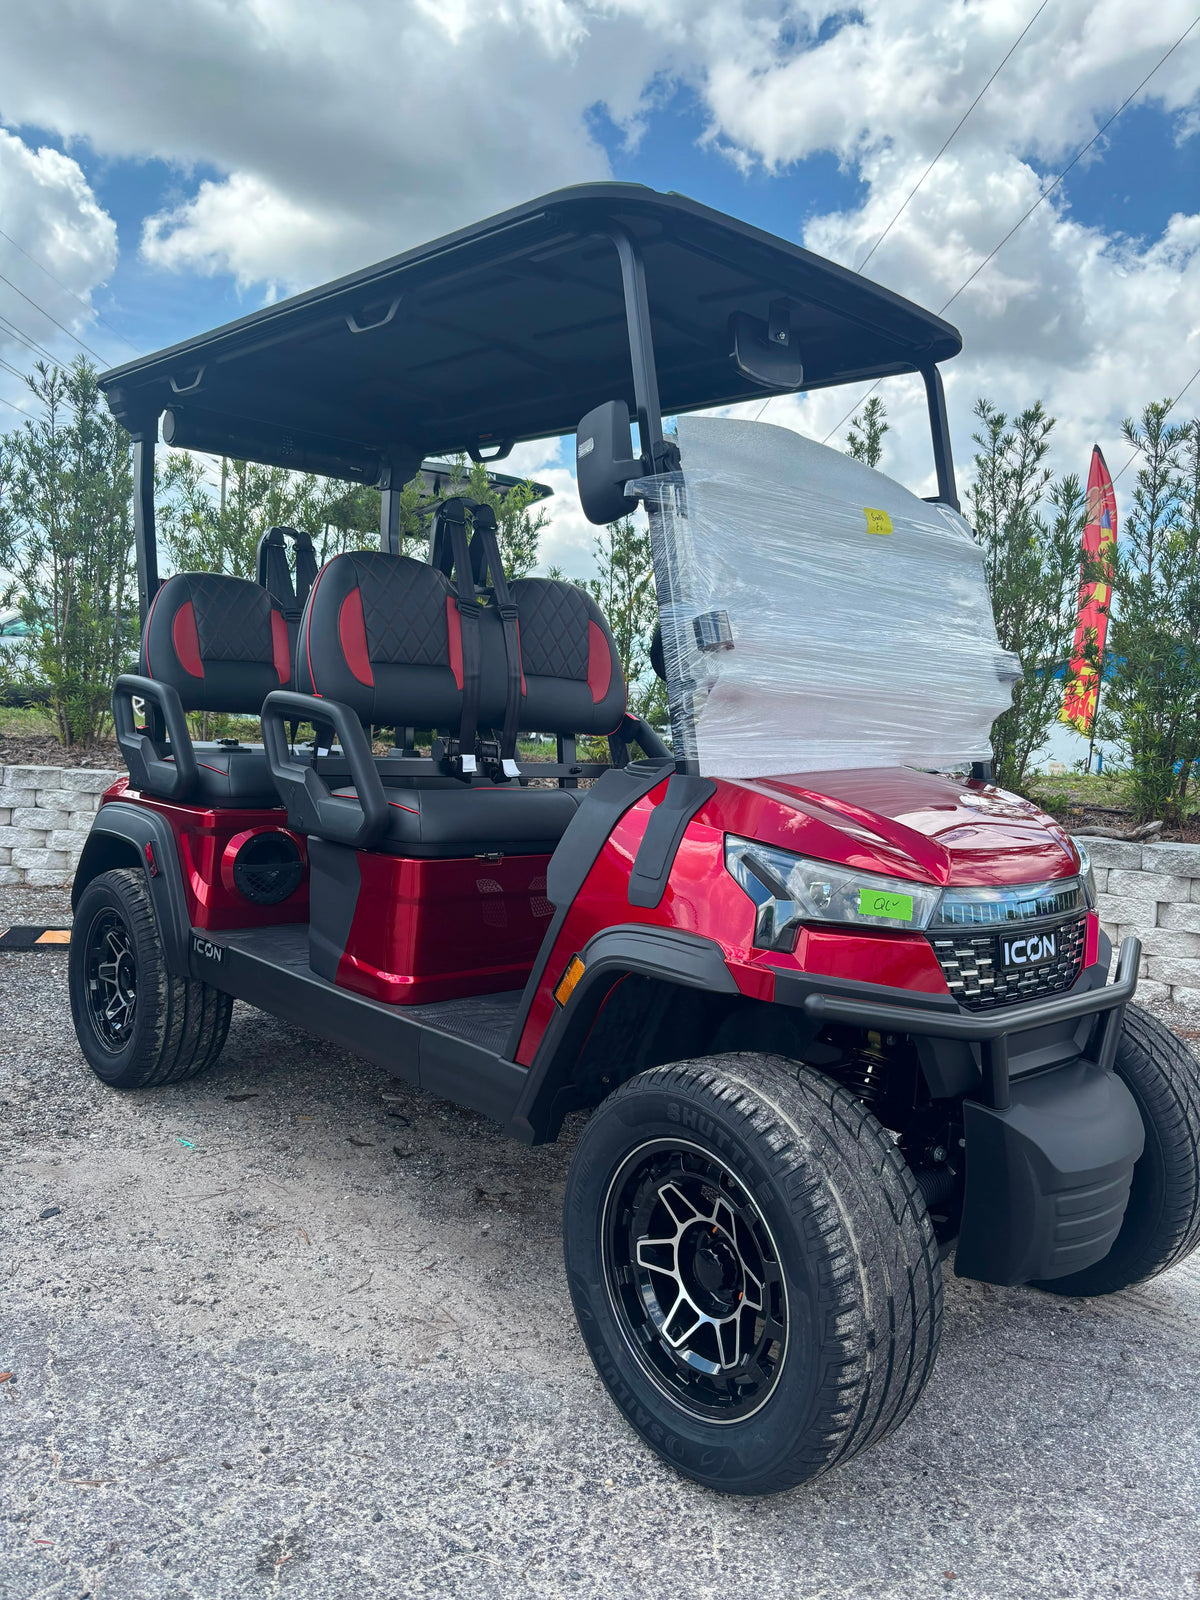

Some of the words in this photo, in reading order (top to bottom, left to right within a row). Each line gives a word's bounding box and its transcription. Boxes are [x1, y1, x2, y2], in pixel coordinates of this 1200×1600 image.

[466, 468, 497, 481] IN
[193, 937, 222, 962] ICON
[1003, 933, 1055, 966] ICON
[666, 1102, 775, 1206] SHUTTLE
[593, 1344, 664, 1441] SAILUN
